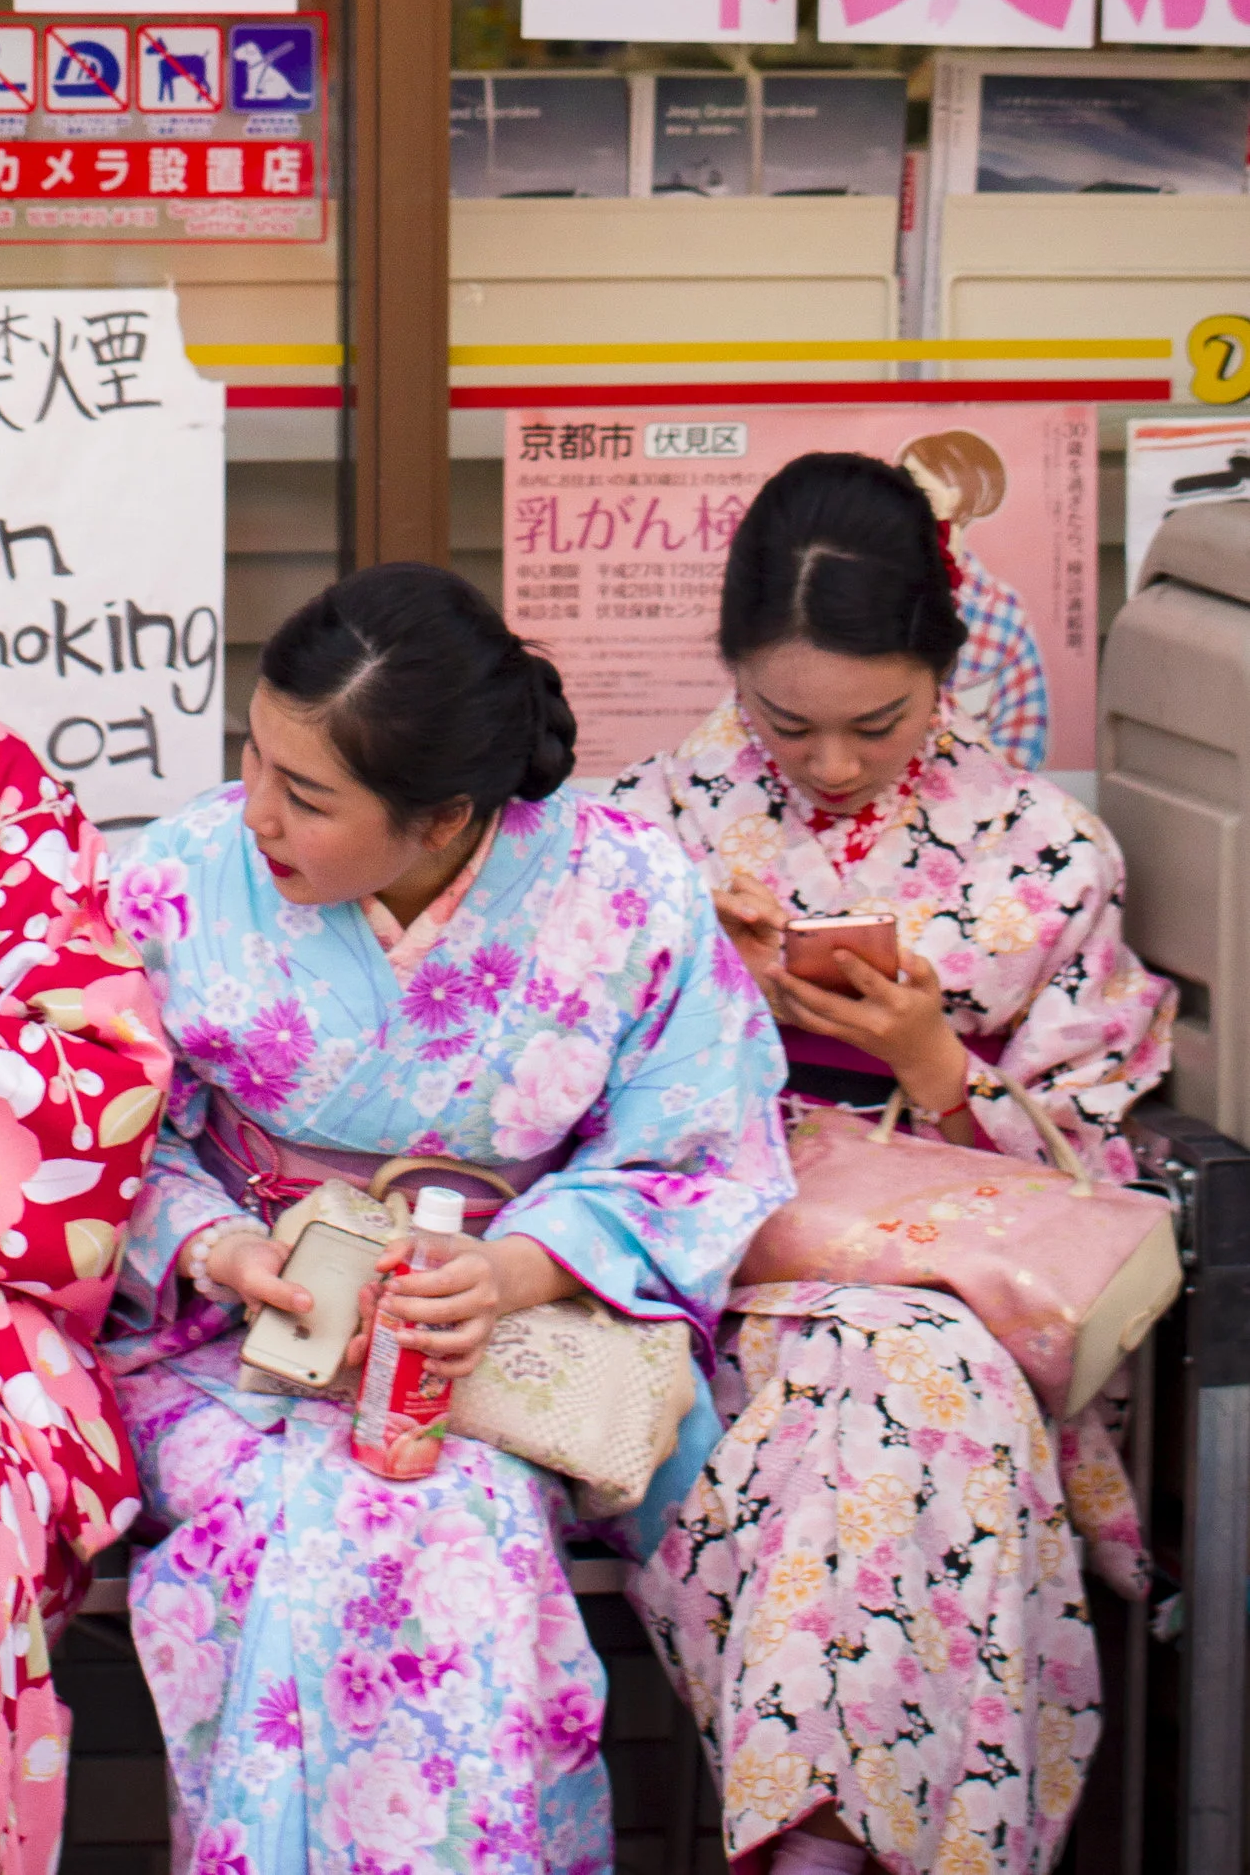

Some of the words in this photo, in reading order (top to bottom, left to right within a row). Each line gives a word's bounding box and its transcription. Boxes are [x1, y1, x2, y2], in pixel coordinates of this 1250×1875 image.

[519, 423, 634, 461] 京都市
[655, 426, 739, 454] 伏見区
